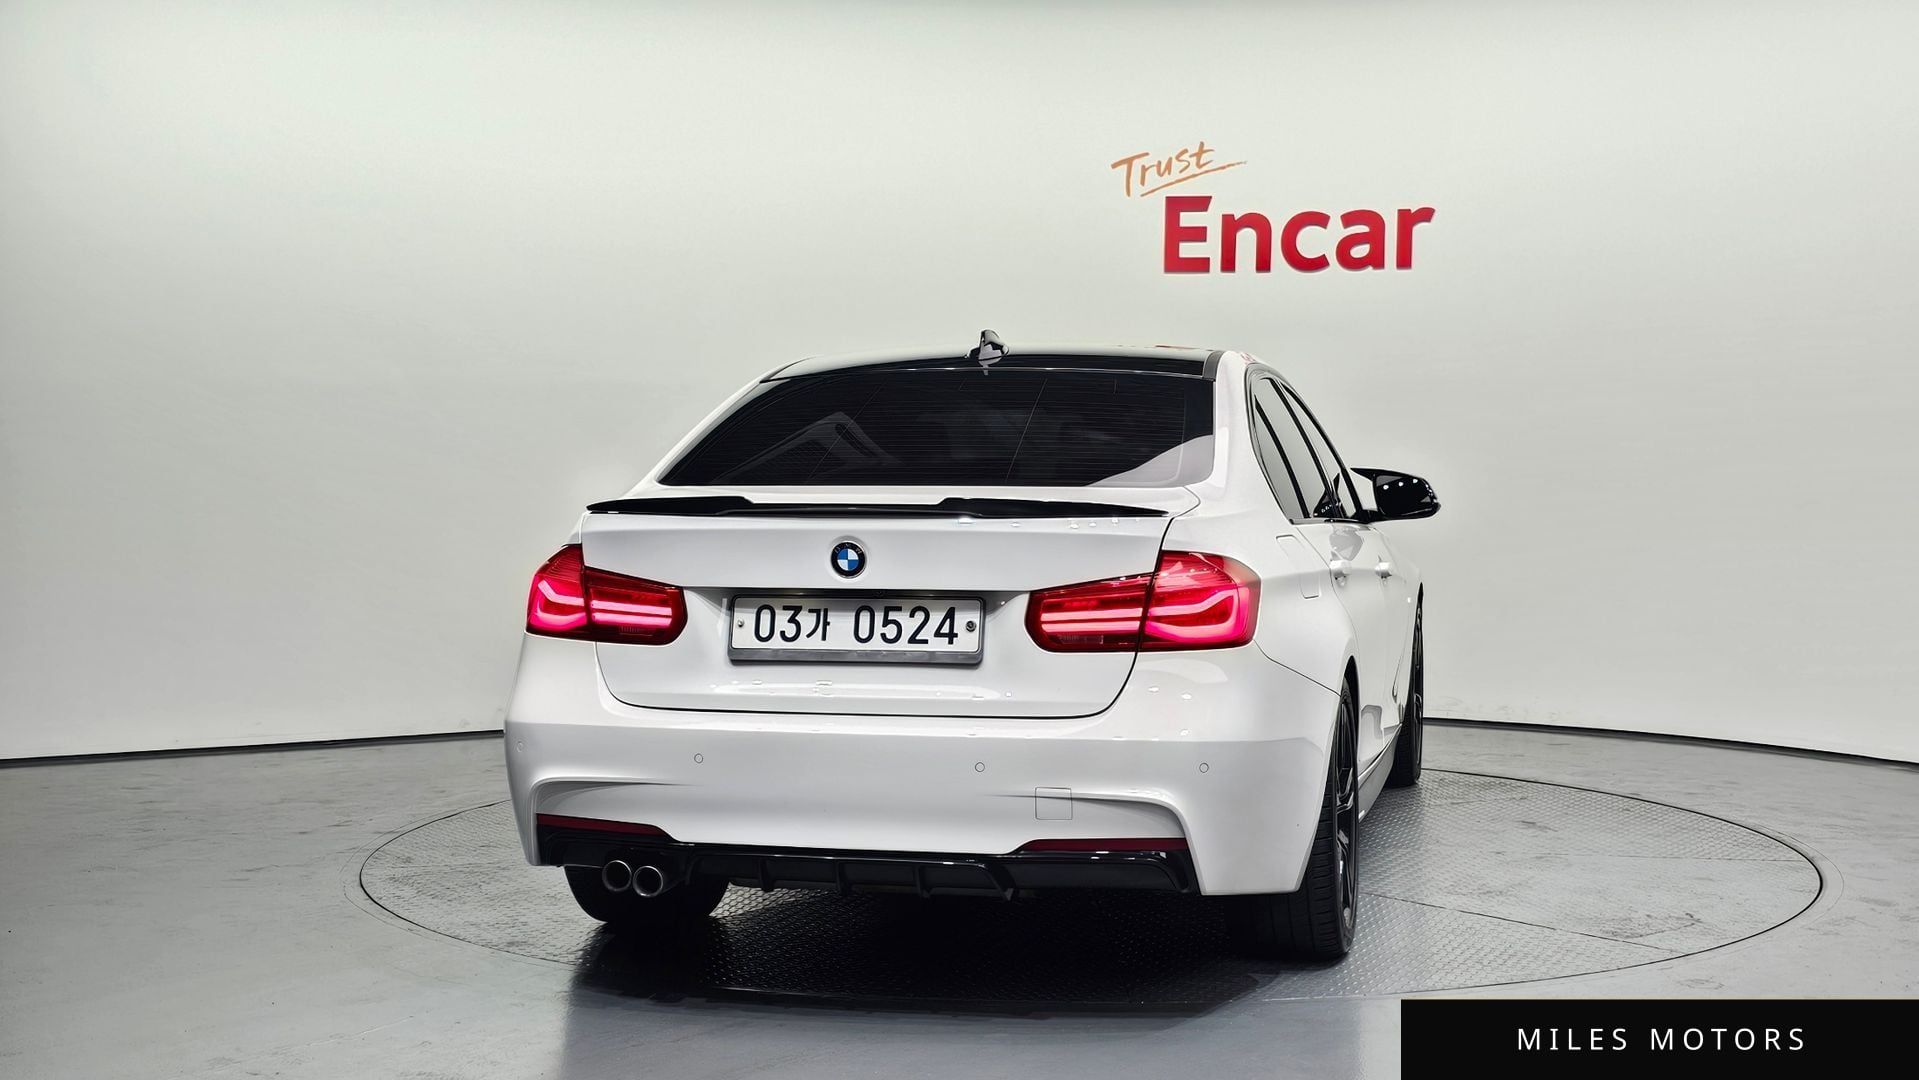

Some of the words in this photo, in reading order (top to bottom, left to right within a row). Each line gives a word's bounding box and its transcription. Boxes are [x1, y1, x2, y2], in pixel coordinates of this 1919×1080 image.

[1111, 141, 1216, 197] Trust
[1164, 195, 1436, 273] Encar
[754, 604, 831, 643] 03가
[853, 605, 958, 645] 0524
